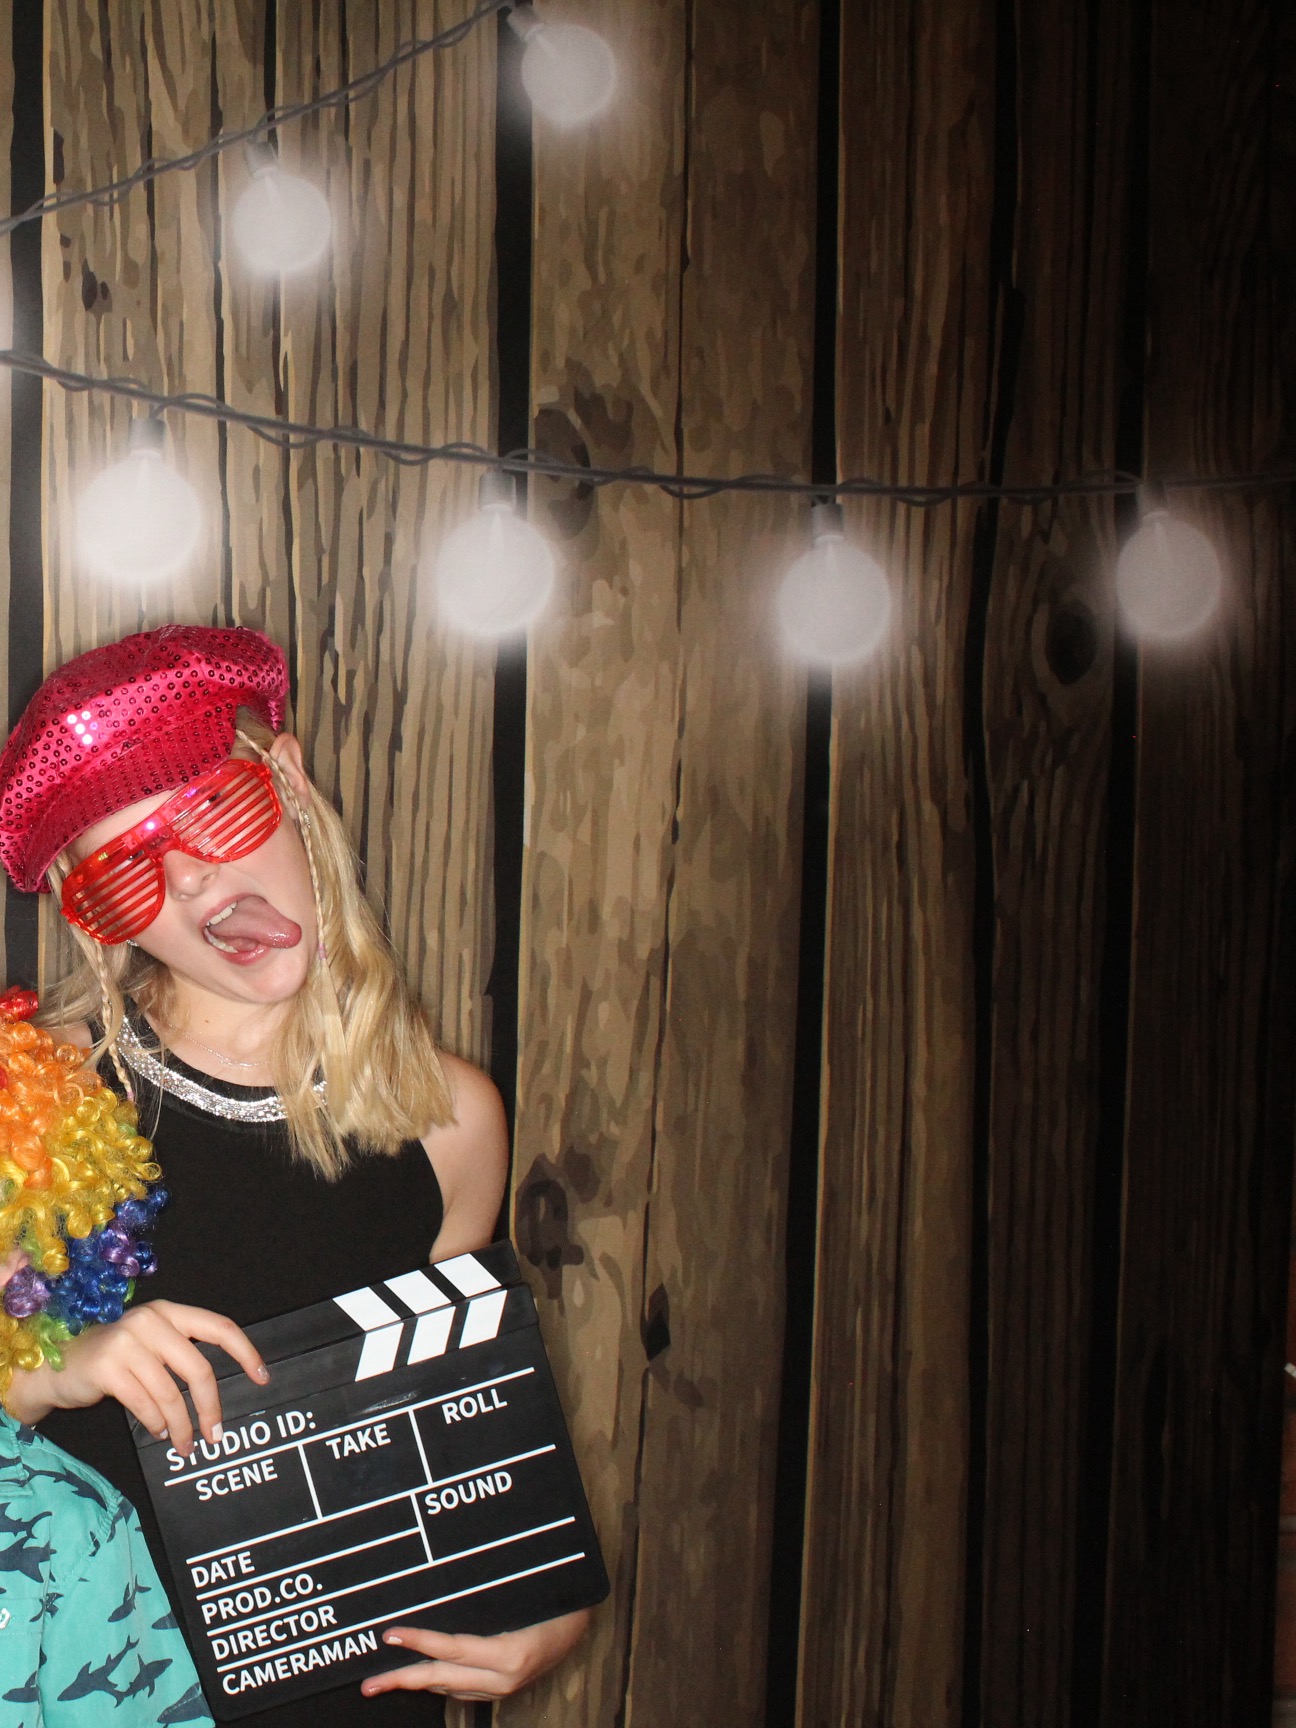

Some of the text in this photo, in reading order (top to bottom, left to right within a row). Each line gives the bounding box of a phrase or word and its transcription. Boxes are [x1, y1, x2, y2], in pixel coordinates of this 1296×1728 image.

[276, 1410, 317, 1438] ID:
[441, 1388, 508, 1425] ROLL
[325, 1423, 392, 1461] TAKE
[195, 1458, 278, 1501] SCENE
[424, 1471, 513, 1516] SOUND
[190, 1551, 256, 1589] DATE
[201, 1572, 324, 1625] PROD.CO.
[210, 1604, 338, 1661] DIRECTOR
[222, 1631, 378, 1695] CAMERAMAN
